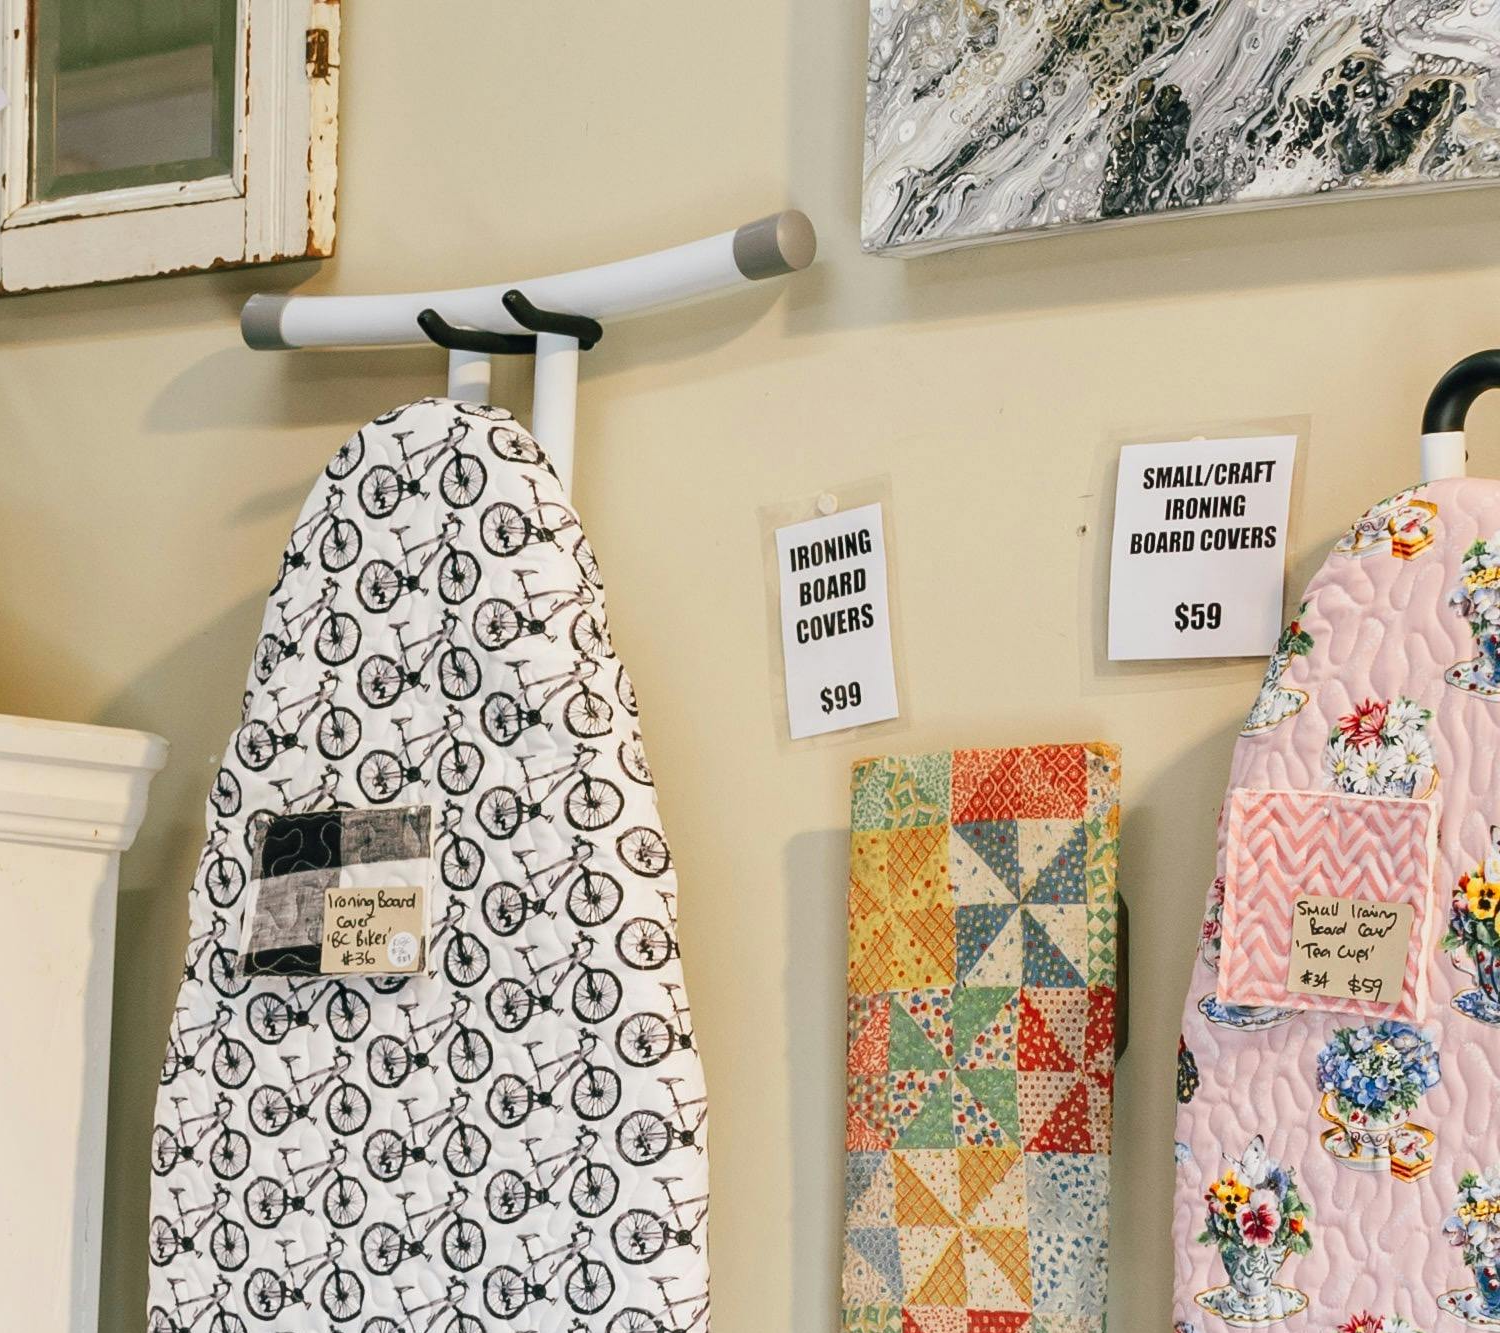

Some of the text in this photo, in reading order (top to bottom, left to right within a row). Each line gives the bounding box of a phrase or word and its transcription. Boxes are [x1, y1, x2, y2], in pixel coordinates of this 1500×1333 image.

[1143, 460, 1276, 490] SMALL/CRAFT
[1165, 495, 1246, 521] IRONING
[790, 529, 872, 572] IRONING
[1130, 525, 1277, 555] BOARD COVERS
[799, 569, 867, 607] BOARD
[796, 604, 875, 645] COVERS
[1174, 602, 1222, 633] $59
[820, 681, 862, 715] $99
[329, 890, 415, 917] Ironing Board
[1297, 901, 1339, 918] Small
[336, 915, 375, 928] Cover
[342, 951, 376, 966] #36
[1348, 977, 1383, 1001] $59
